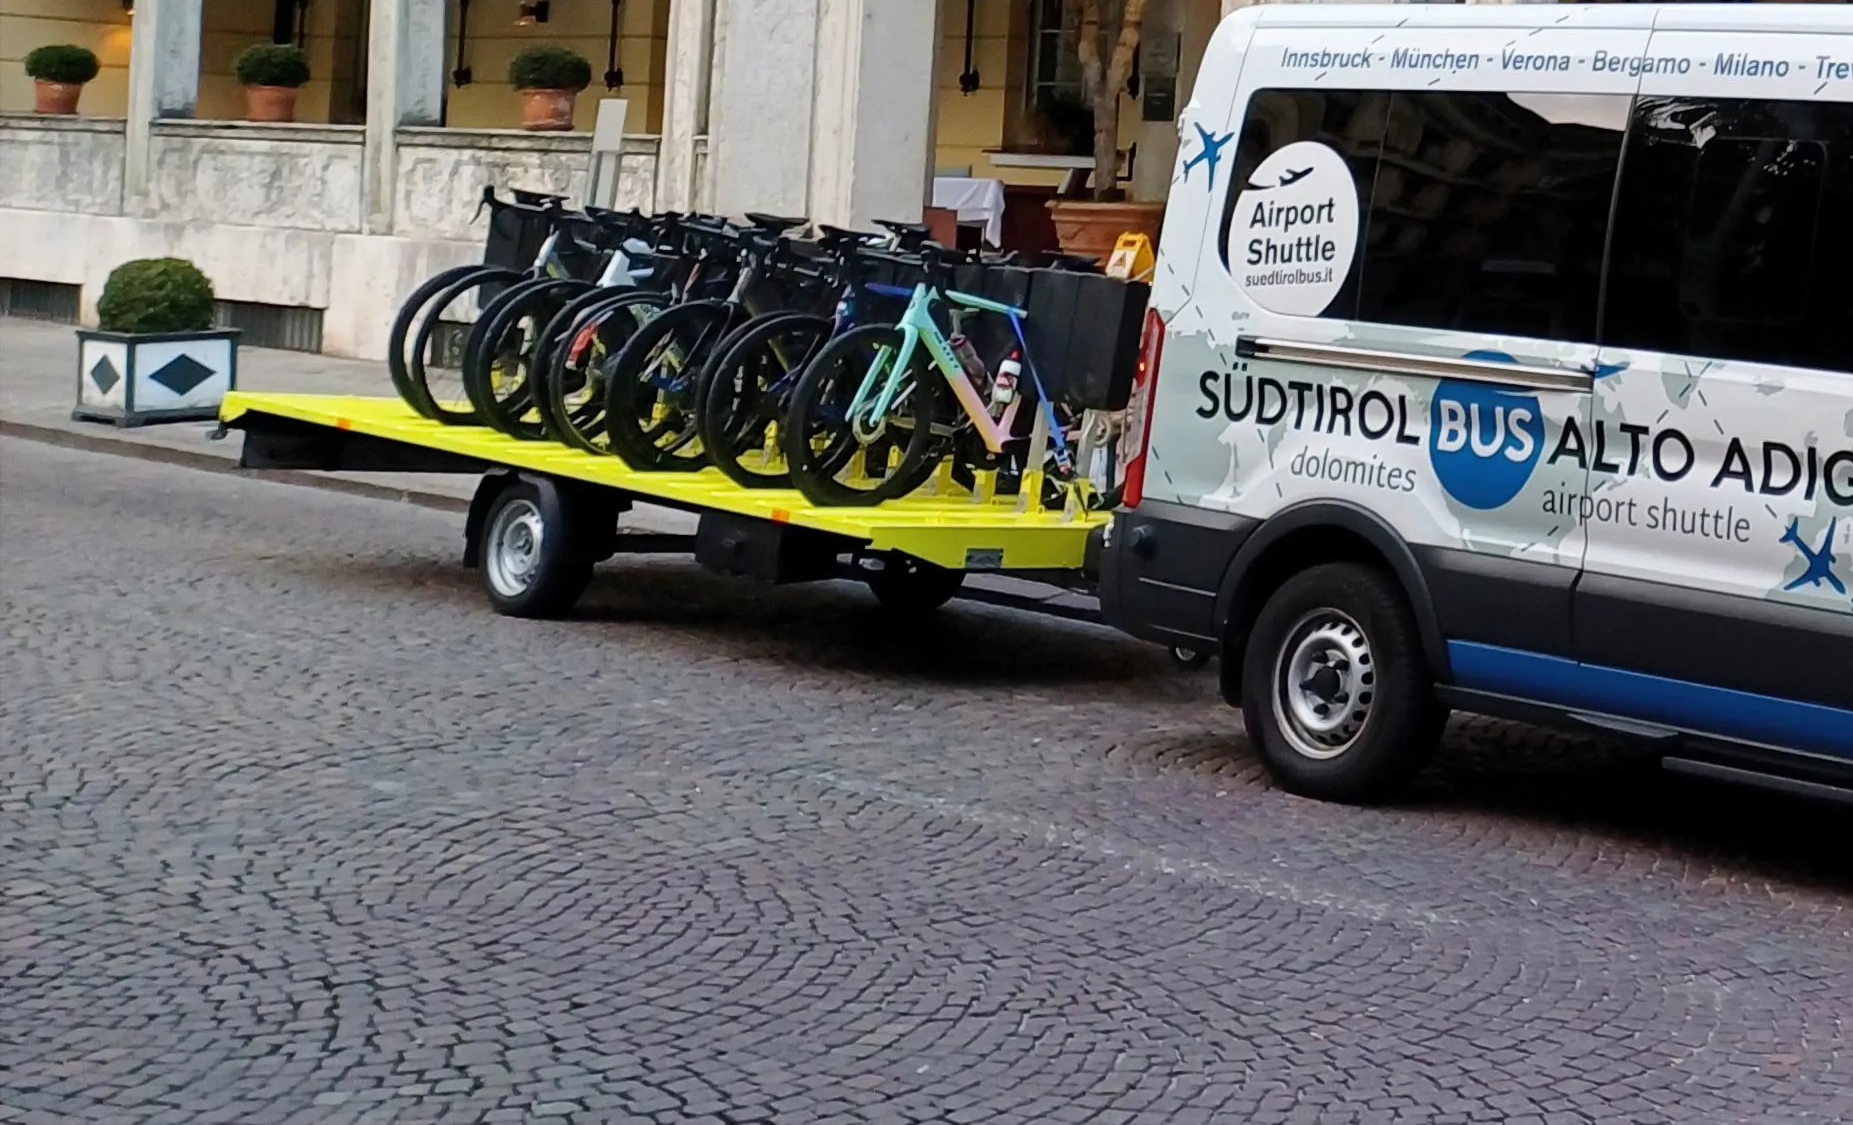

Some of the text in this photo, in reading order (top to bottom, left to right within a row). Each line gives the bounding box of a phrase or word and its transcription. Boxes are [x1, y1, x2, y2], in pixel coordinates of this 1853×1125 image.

[1281, 47, 1375, 68] Innsbruck
[1390, 47, 1479, 70] München
[1502, 48, 1570, 70] Verona
[1592, 50, 1691, 77] Bergamo
[1713, 52, 1789, 77] Milano
[1249, 197, 1336, 233] Airport
[1247, 234, 1336, 265] Shuttle
[1245, 268, 1333, 287] suedtirolbus.it
[1196, 362, 1420, 446] SÜDTIROL
[1437, 399, 1534, 462] BUS
[1547, 416, 1695, 482] ALTO
[1290, 445, 1417, 492] dolomites
[1542, 481, 1750, 543] airport shuttle
